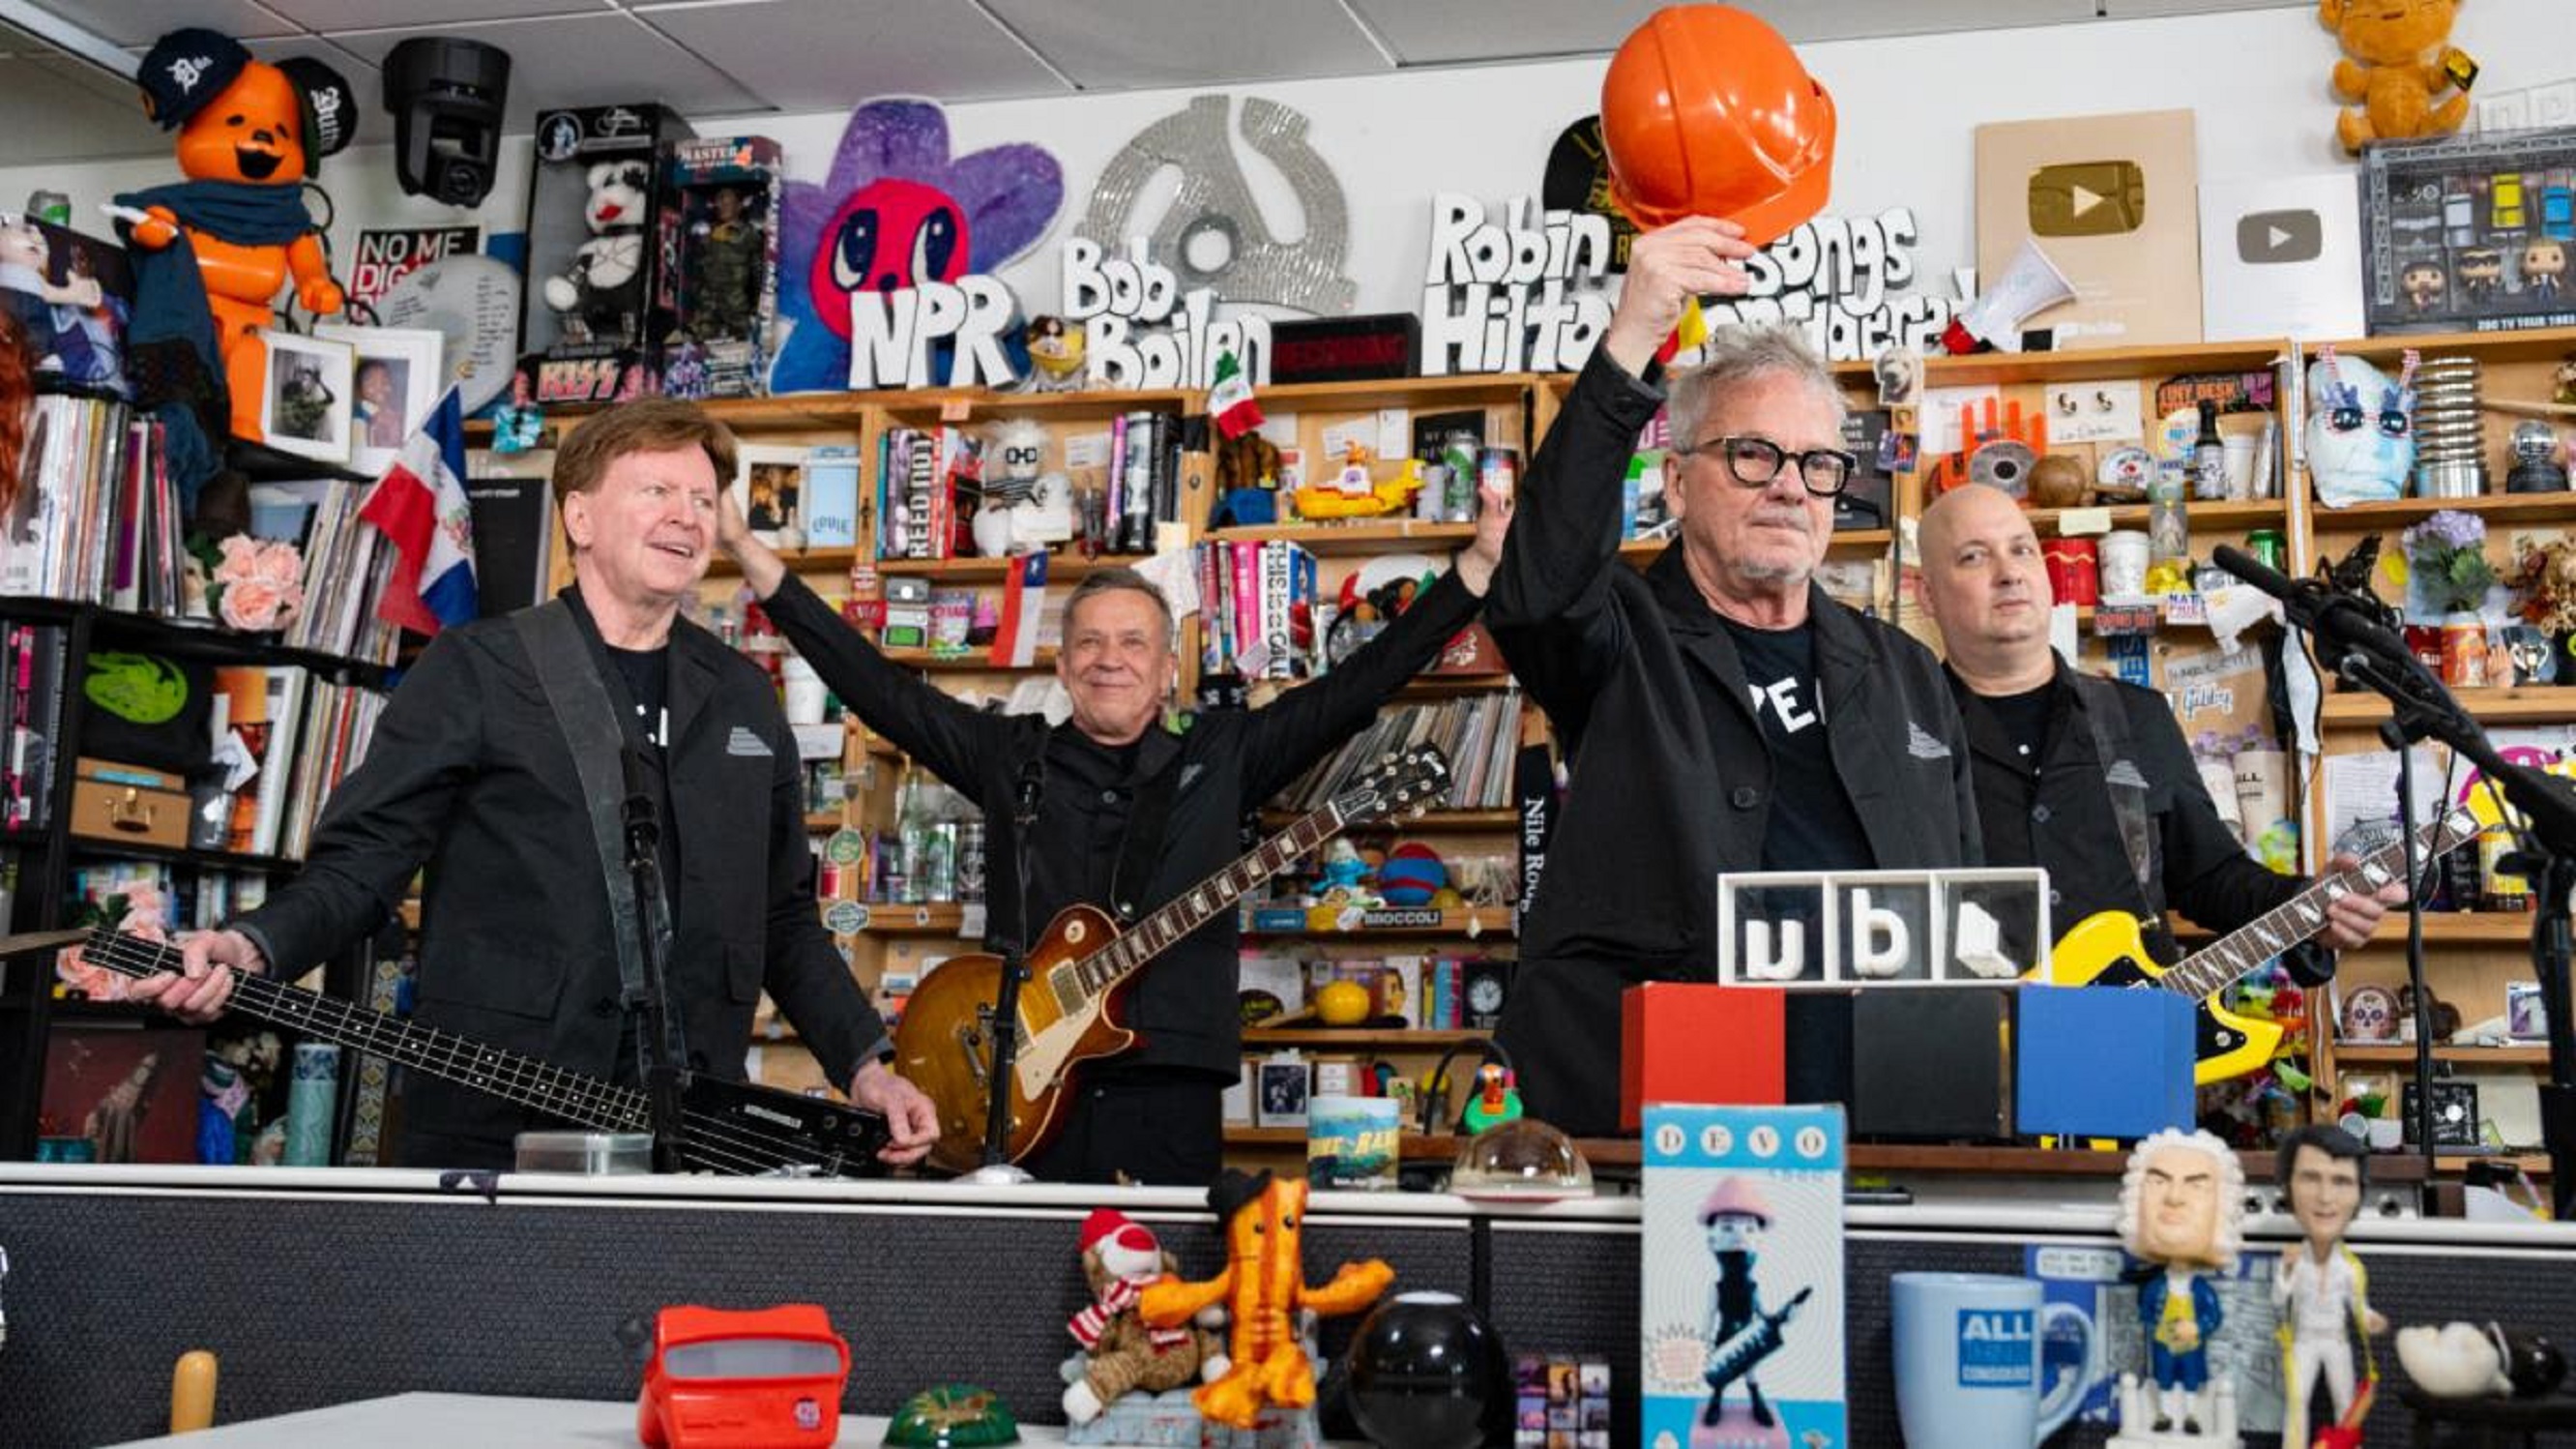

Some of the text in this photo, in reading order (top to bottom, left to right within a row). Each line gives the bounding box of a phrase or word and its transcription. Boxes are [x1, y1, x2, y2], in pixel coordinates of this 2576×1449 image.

[362, 234, 410, 262] NO
[1426, 193, 1611, 284] Robin
[1064, 238, 1177, 320] Bob
[848, 275, 1022, 392] NPR
[1090, 288, 1271, 392] Boilen
[1421, 278, 1621, 377] Hilto
[538, 358, 623, 402] KISS
[909, 493, 930, 558] REED
[1524, 796, 1545, 847] Nile
[1364, 912, 1440, 926] BROCCOLI
[1962, 1314, 2031, 1342] ALL
